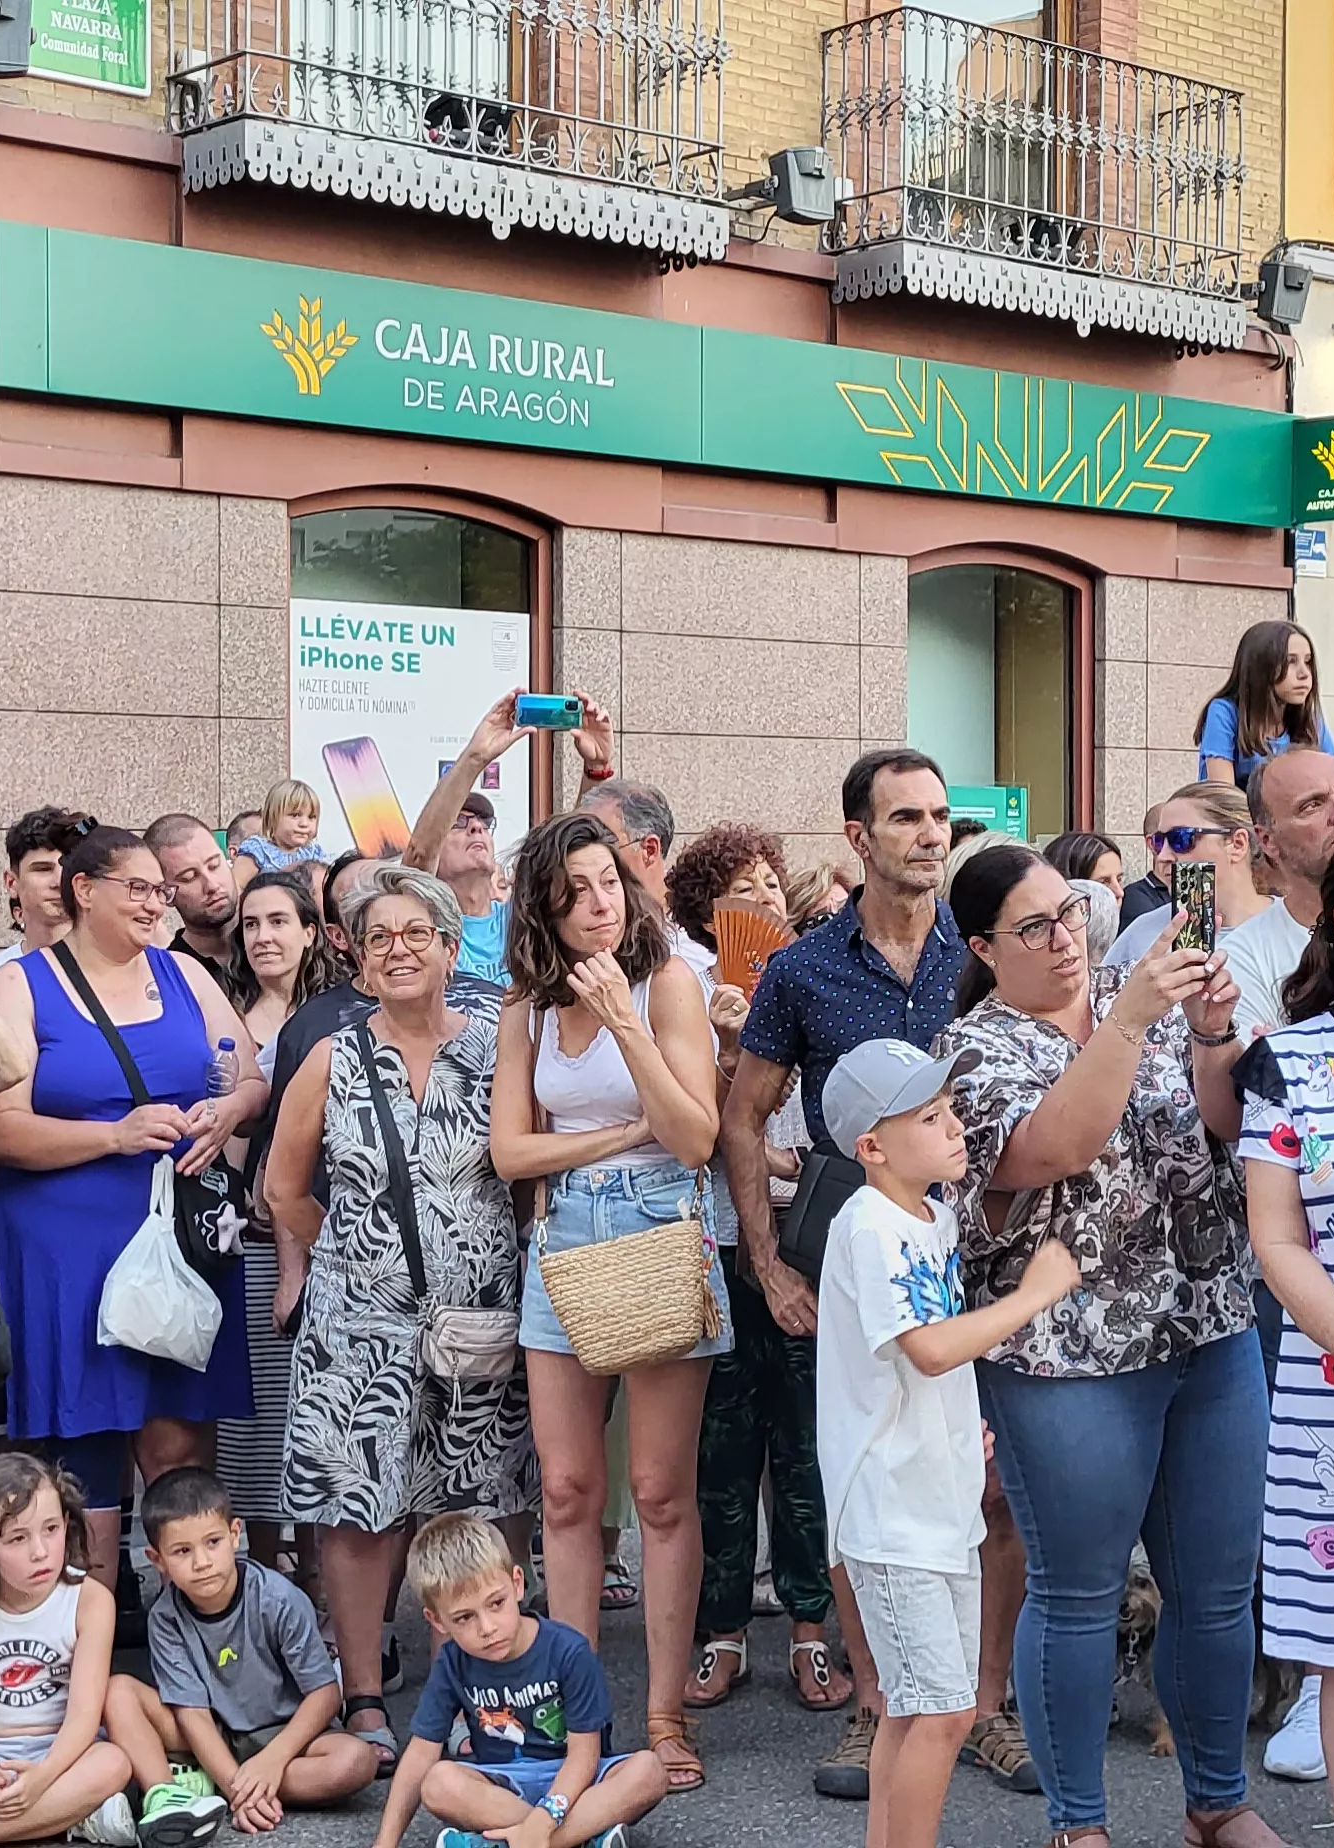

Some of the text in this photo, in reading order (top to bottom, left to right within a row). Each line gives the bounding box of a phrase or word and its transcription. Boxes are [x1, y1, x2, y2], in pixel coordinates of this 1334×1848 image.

[50, 10, 123, 41] NAVARRA
[40, 33, 129, 65] Comunidad Foral
[374, 318, 615, 387] CAJA RURAL
[404, 378, 590, 428] DE ARAGÓN
[300, 613, 455, 647] LLÉVATE UN
[300, 645, 421, 673] iPhone SE
[298, 678, 370, 696] HAZTE CLIENTE
[299, 696, 305, 710] Y
[307, 696, 355, 713] DOMICILIA
[358, 698, 370, 713] TU
[503, 1681, 559, 1708] ANIMA
